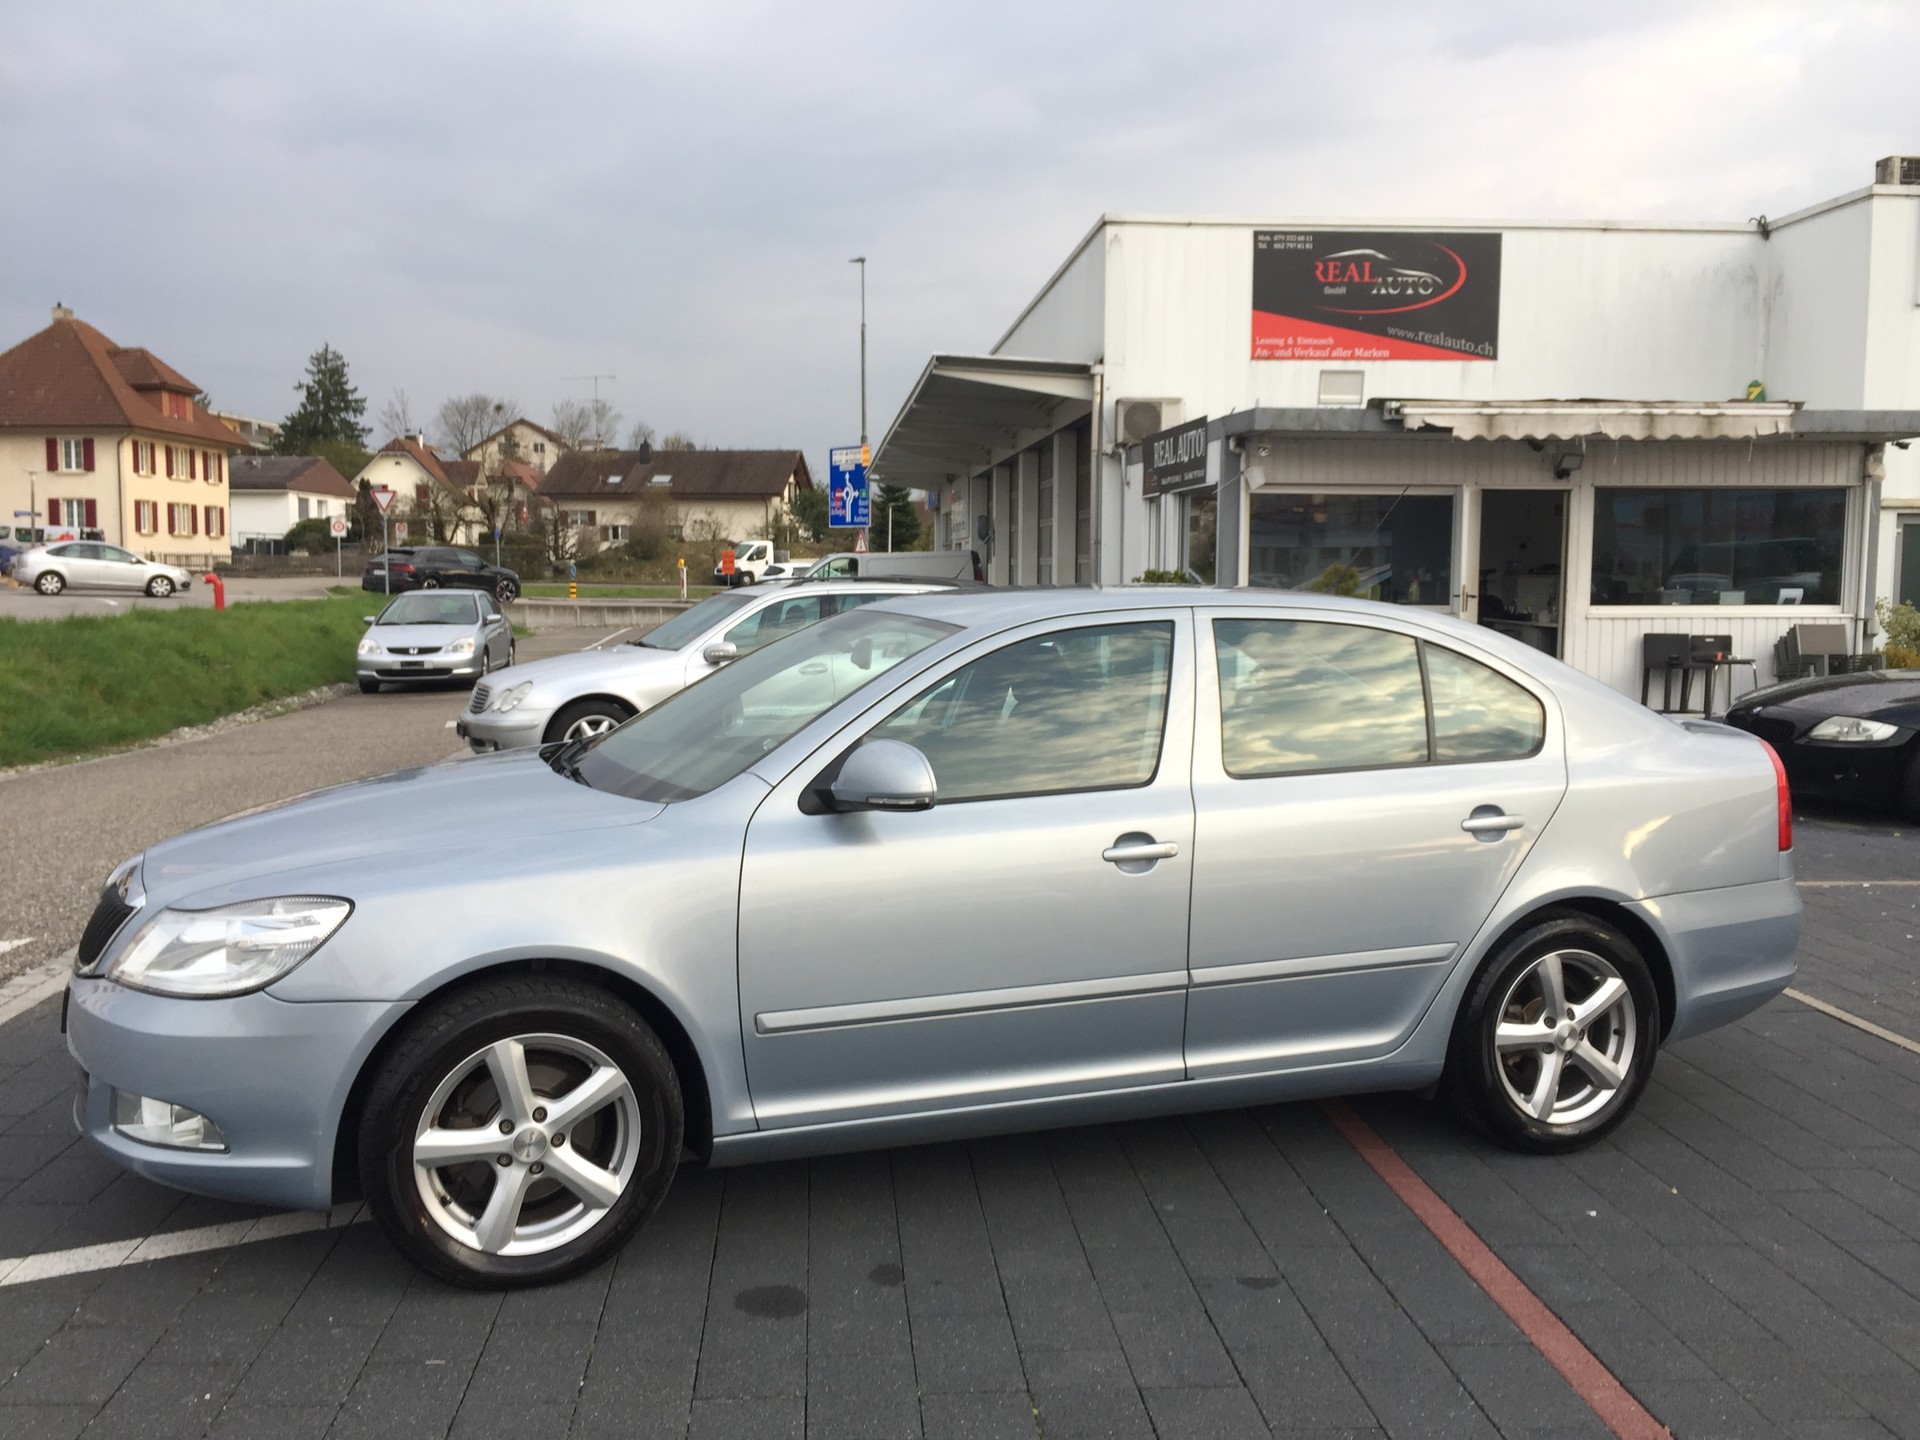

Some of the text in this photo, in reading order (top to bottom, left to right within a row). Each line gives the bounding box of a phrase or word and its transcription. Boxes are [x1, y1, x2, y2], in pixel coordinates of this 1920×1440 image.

[1315, 261, 1377, 283] REAL
[1371, 277, 1433, 295] AUTO
[1387, 326, 1493, 356] www.realauto.ch
[1273, 347, 1292, 358] und
[1294, 347, 1330, 358] Verkauf
[1331, 347, 1353, 358] aller
[1354, 347, 1390, 358] Marken
[1153, 437, 1176, 469] REAL
[1176, 427, 1203, 463] AUTO
